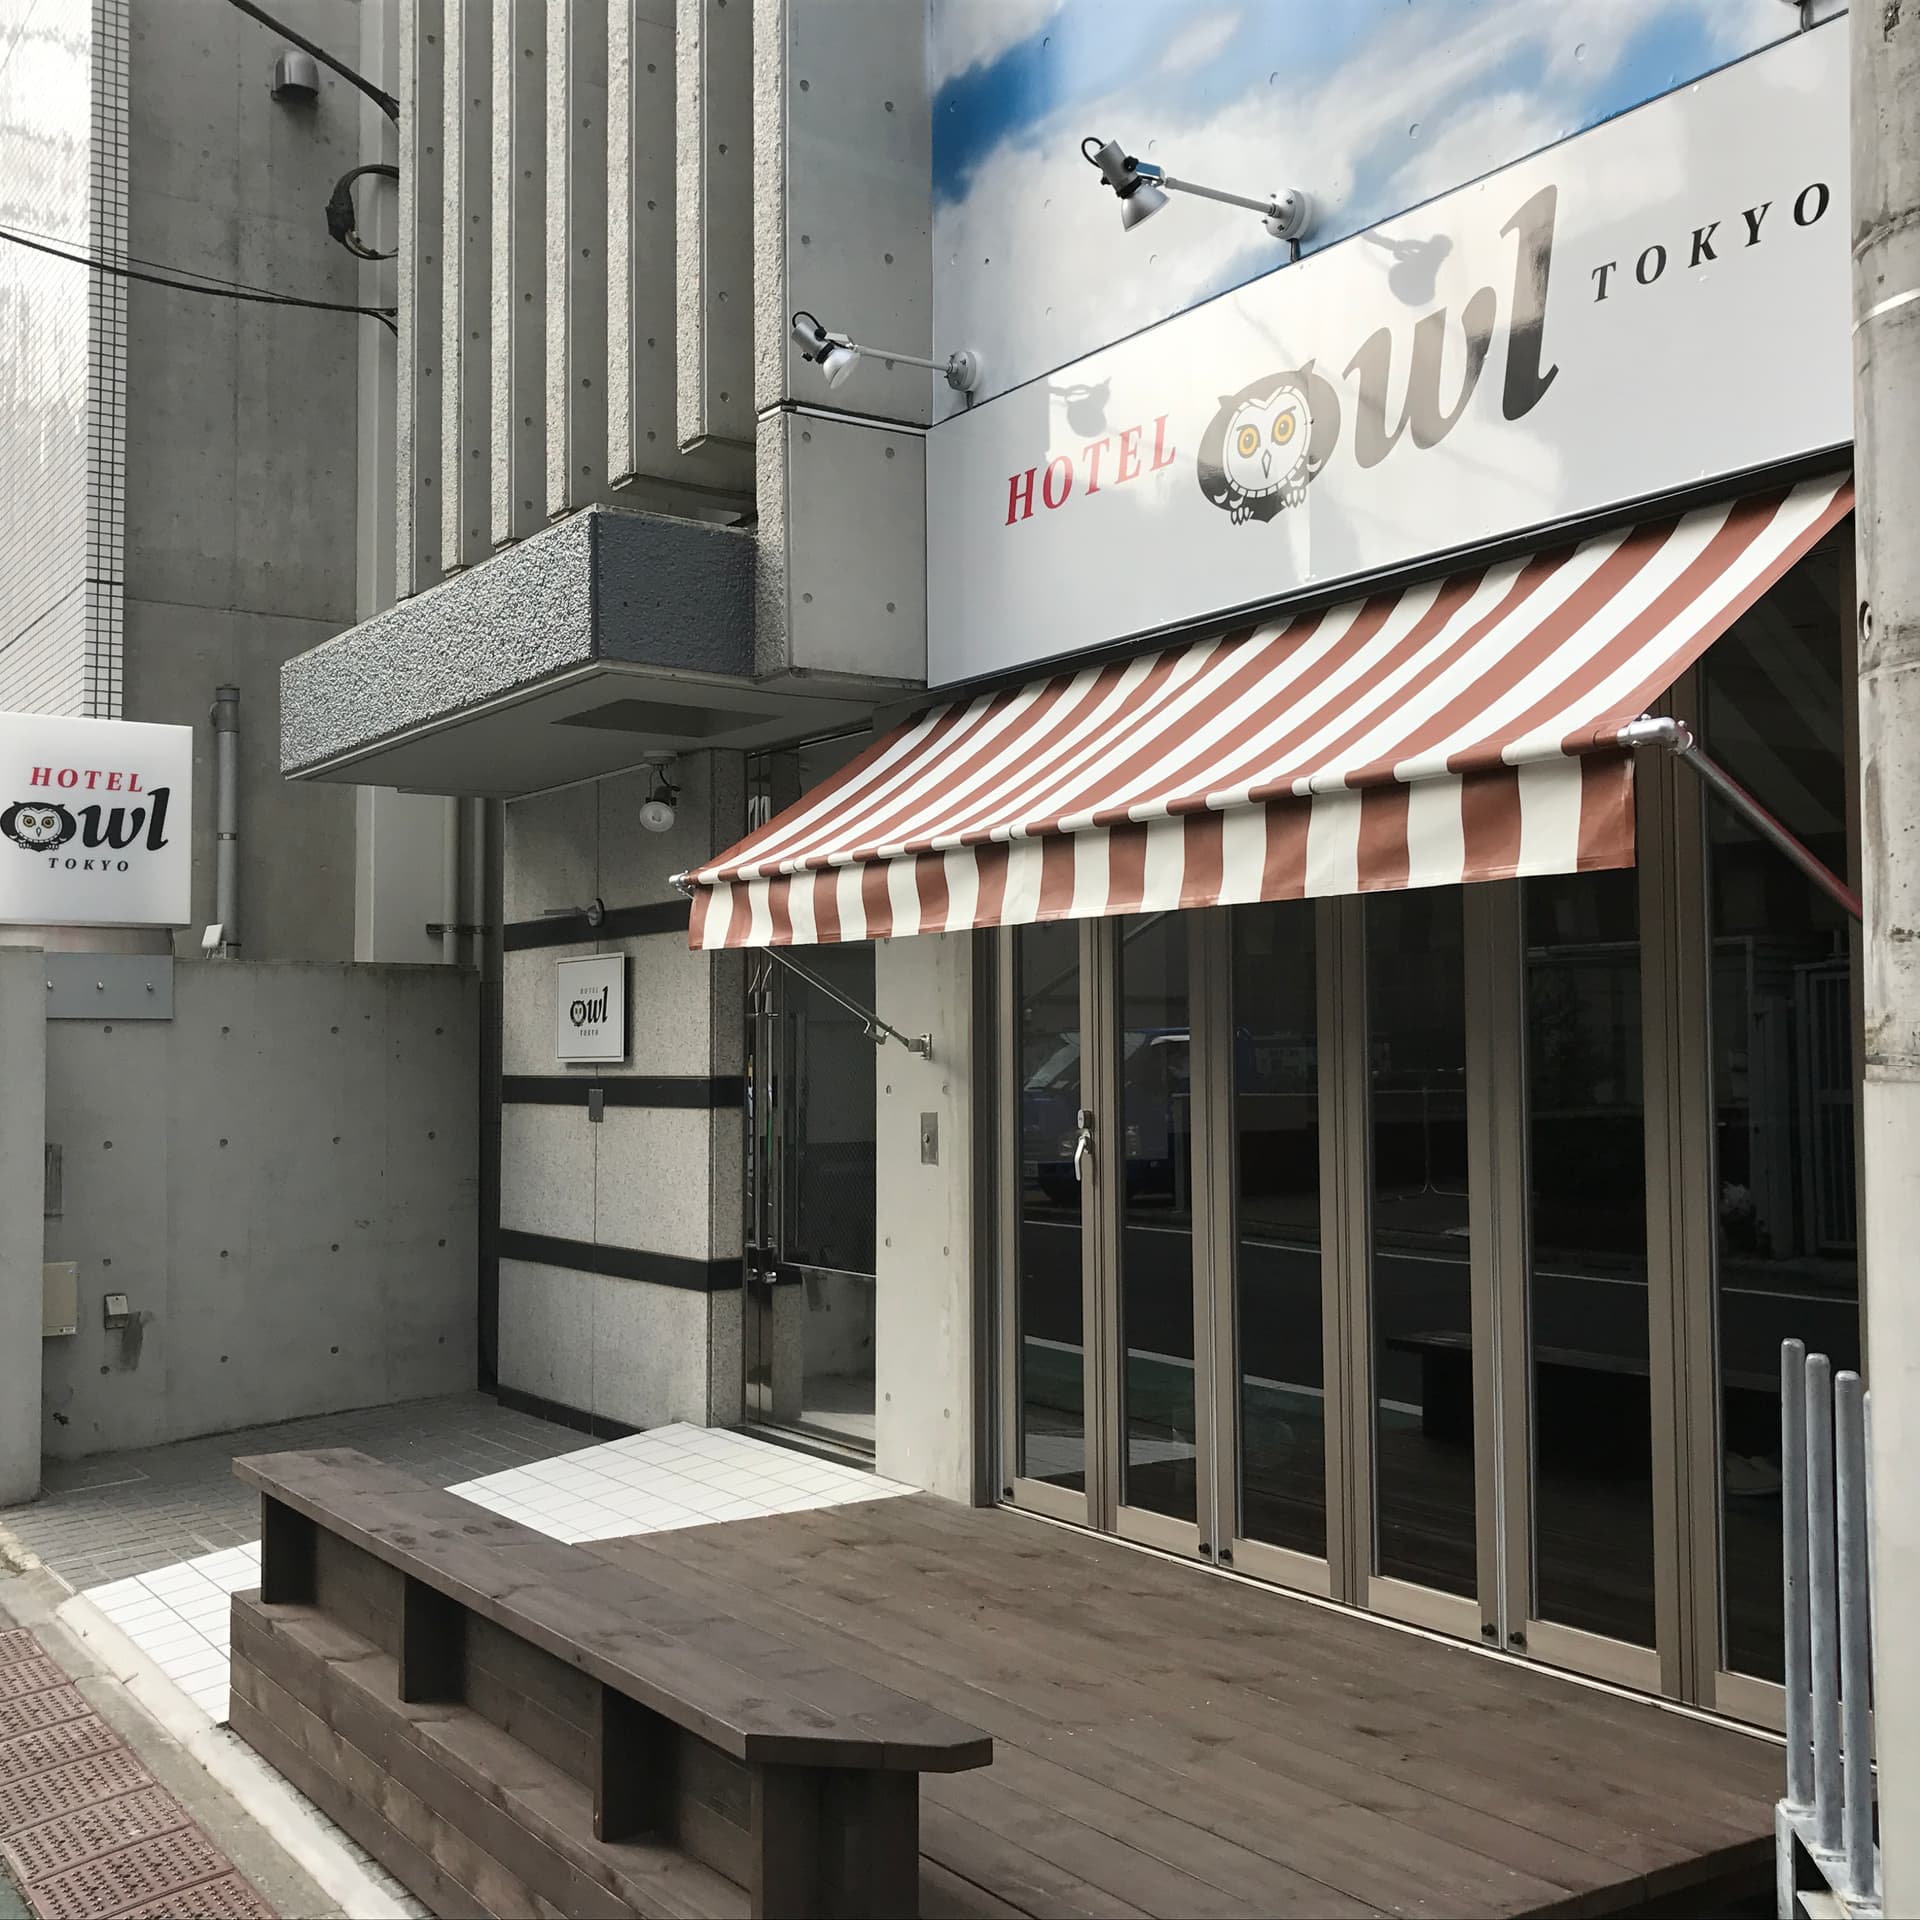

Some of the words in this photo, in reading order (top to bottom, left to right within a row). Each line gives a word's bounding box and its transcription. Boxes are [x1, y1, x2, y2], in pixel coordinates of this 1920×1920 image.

[1004, 414, 1176, 526] HOTEL
[1591, 182, 1830, 303] TOKYO
[29, 766, 144, 793] HOTEL
[48, 857, 129, 872] TOKYO
